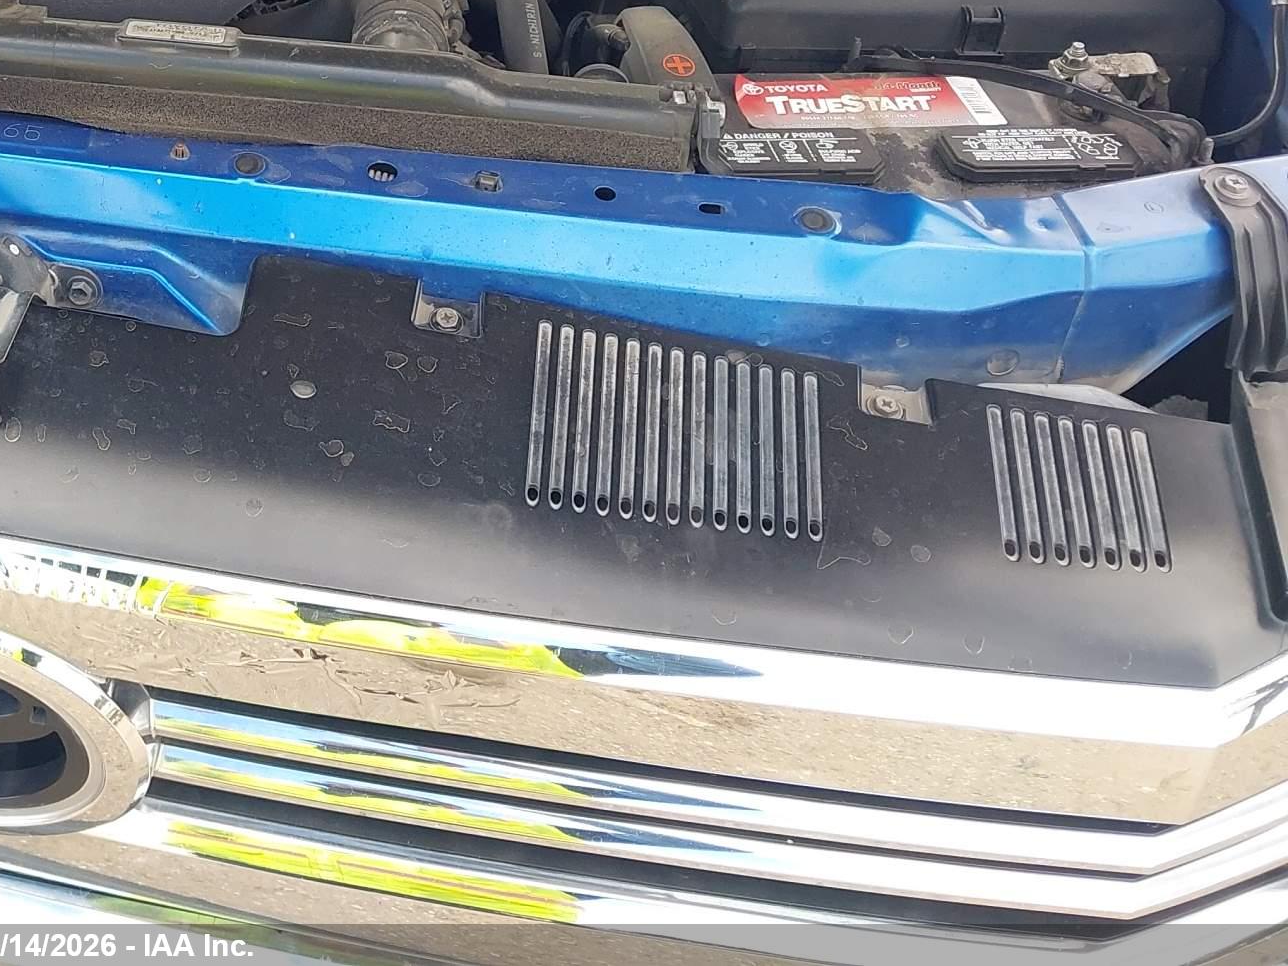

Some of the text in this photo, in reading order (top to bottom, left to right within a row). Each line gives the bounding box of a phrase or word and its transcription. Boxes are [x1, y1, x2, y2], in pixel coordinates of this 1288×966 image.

[765, 83, 828, 94] TOYOTA
[733, 132, 782, 140] DANGER
[792, 131, 834, 139] POISON
